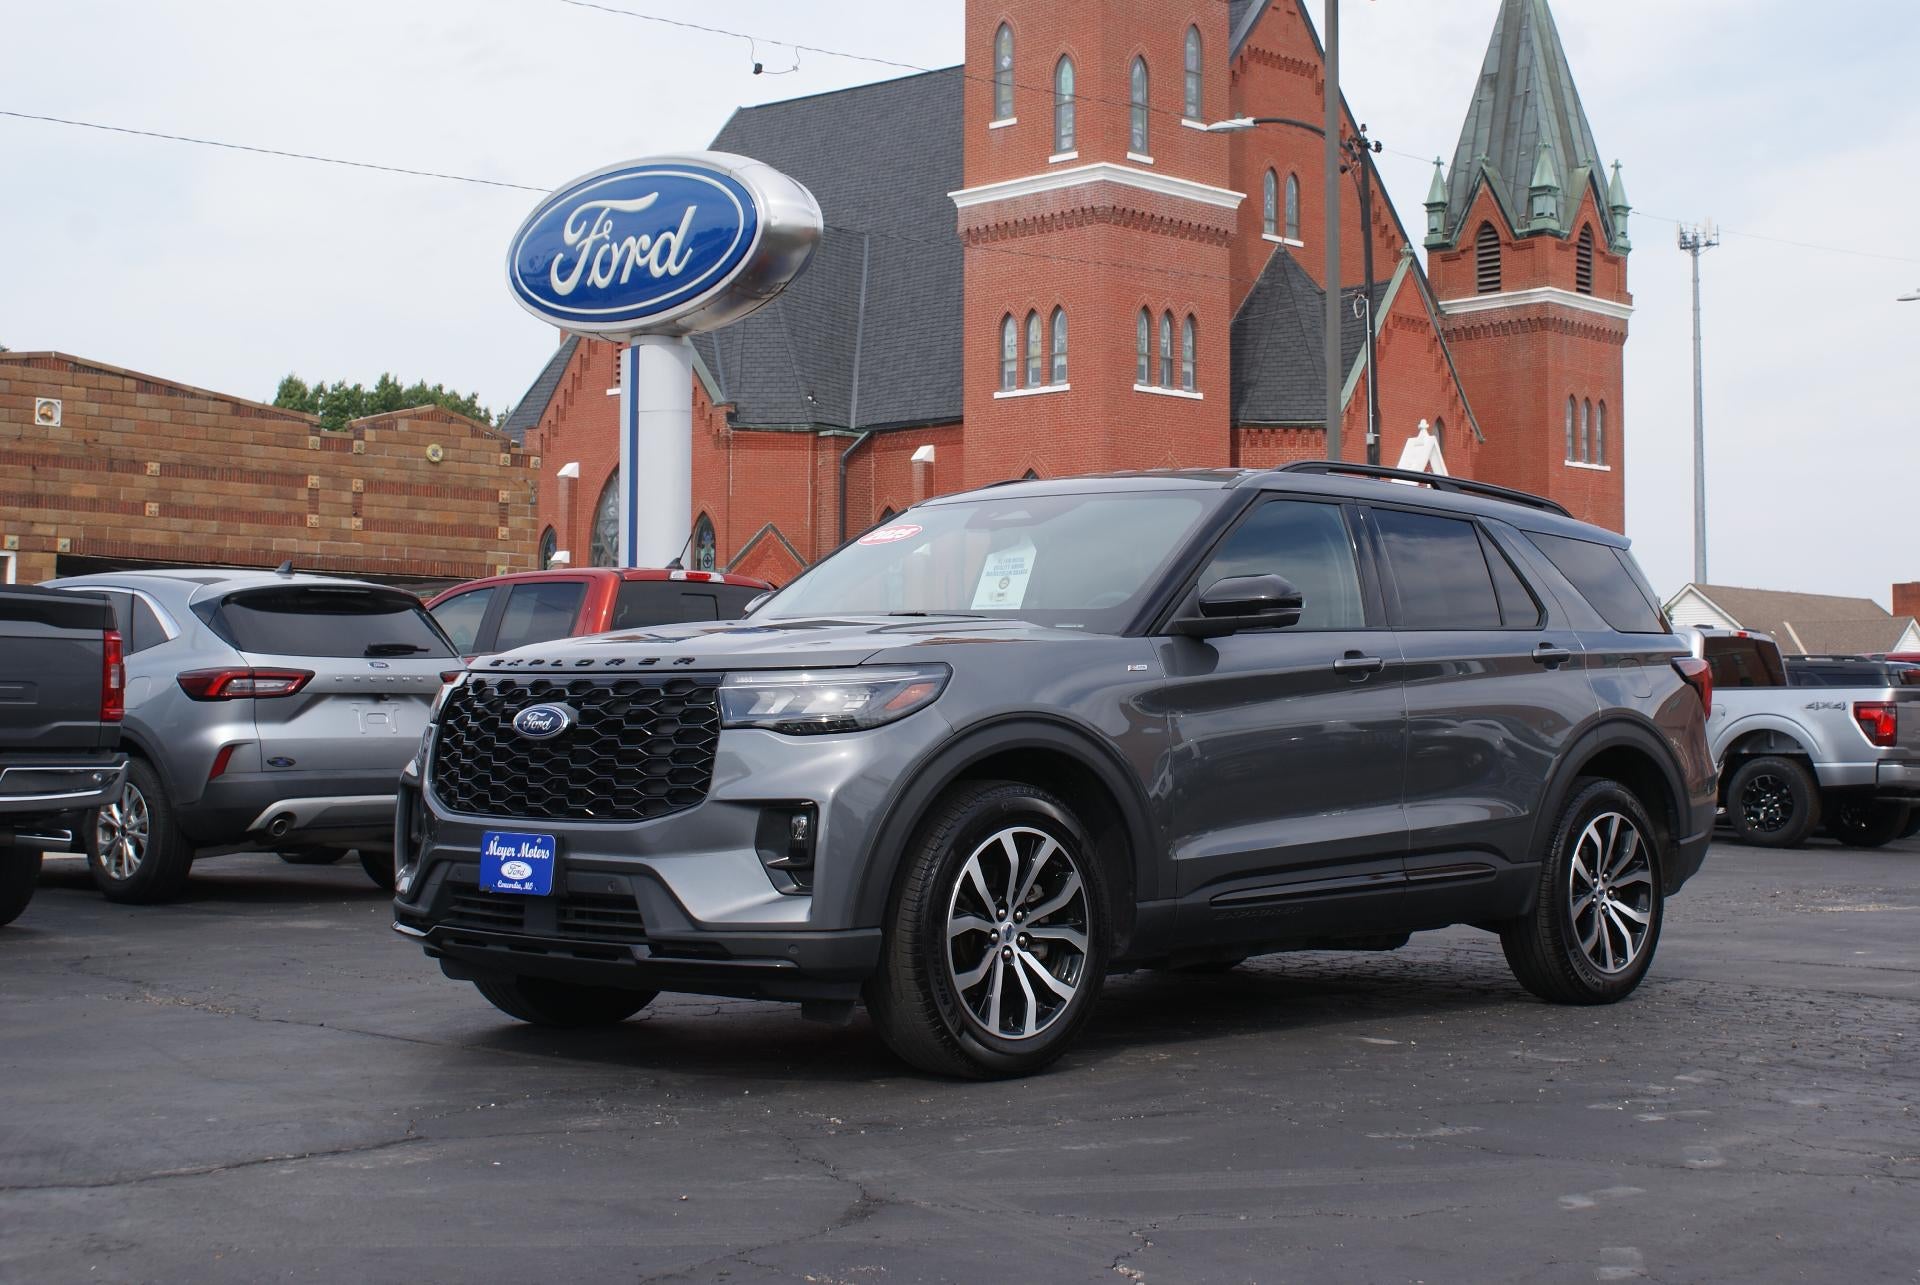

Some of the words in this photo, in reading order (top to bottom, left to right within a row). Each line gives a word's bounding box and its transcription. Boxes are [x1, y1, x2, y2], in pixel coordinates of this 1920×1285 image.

[550, 191, 697, 296] Ford
[489, 657, 696, 667] EXPLORER
[522, 711, 553, 731] Ford
[485, 840, 515, 861] Meyer
[517, 842, 550, 859] Motors
[507, 863, 526, 877] Ford
